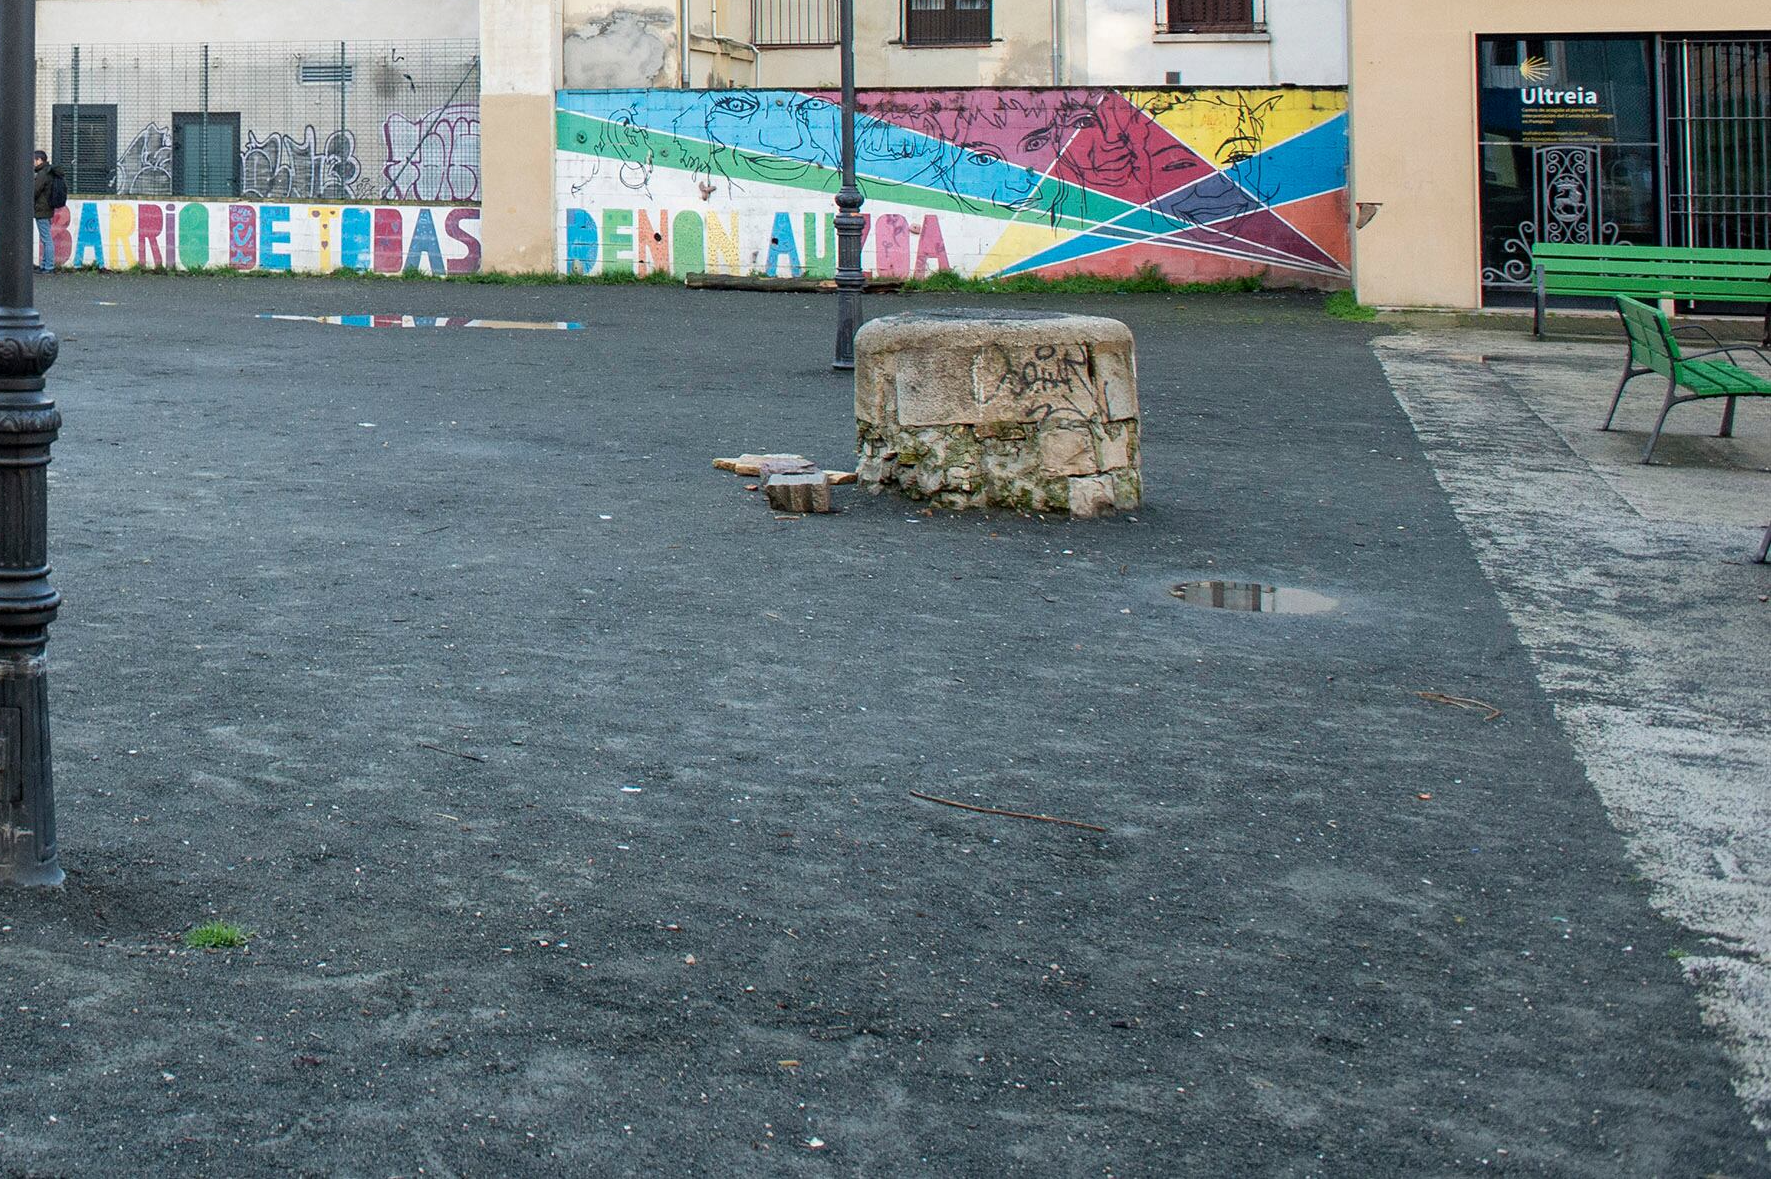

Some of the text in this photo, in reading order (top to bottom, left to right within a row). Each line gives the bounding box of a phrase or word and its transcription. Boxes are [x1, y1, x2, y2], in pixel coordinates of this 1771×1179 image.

[1521, 86, 1597, 105] Ultreia
[229, 205, 292, 270] DE
[308, 206, 482, 275] TODAS
[566, 208, 741, 277] DENON
